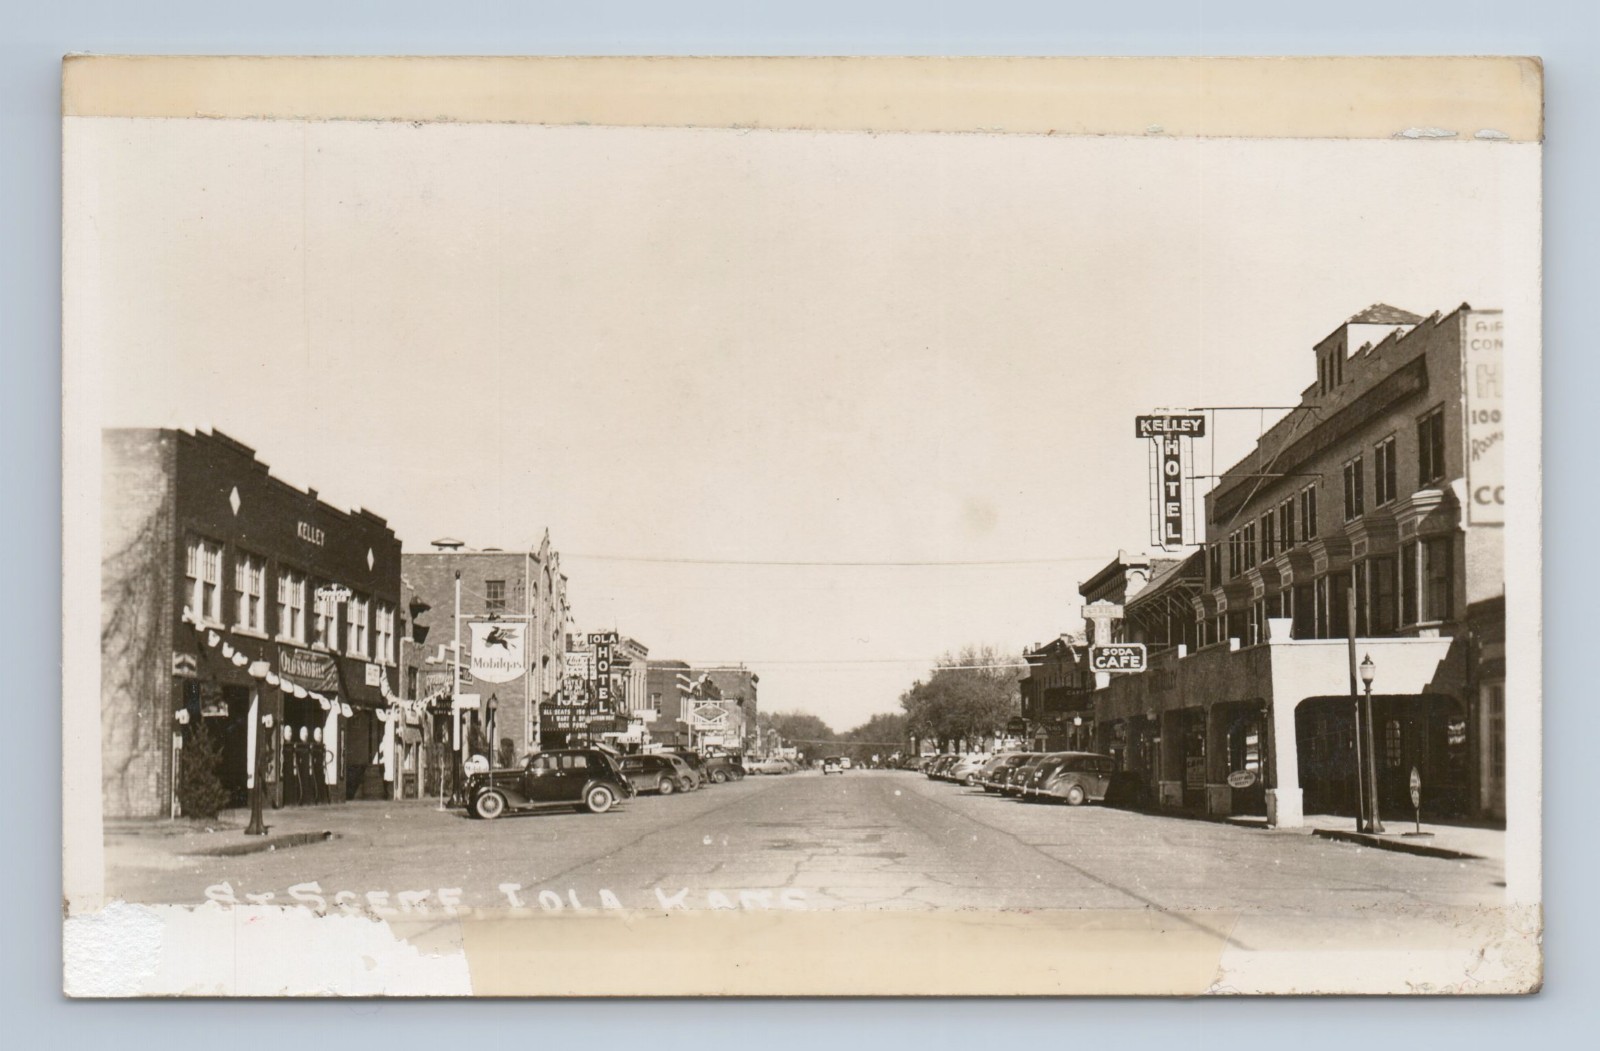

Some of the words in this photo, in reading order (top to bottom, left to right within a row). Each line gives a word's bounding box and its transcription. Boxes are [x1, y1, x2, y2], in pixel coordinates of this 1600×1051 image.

[1472, 409, 1502, 425] 100
[1140, 418, 1202, 434] KELLEY
[1164, 439, 1181, 540] HOTEL
[297, 520, 325, 547] KELLEY
[590, 635, 617, 644] IOLA
[1102, 647, 1134, 656] SODA
[473, 657, 523, 673] Mobilgas
[1095, 655, 1141, 669] CAFE
[597, 646, 609, 713] HOTEL
